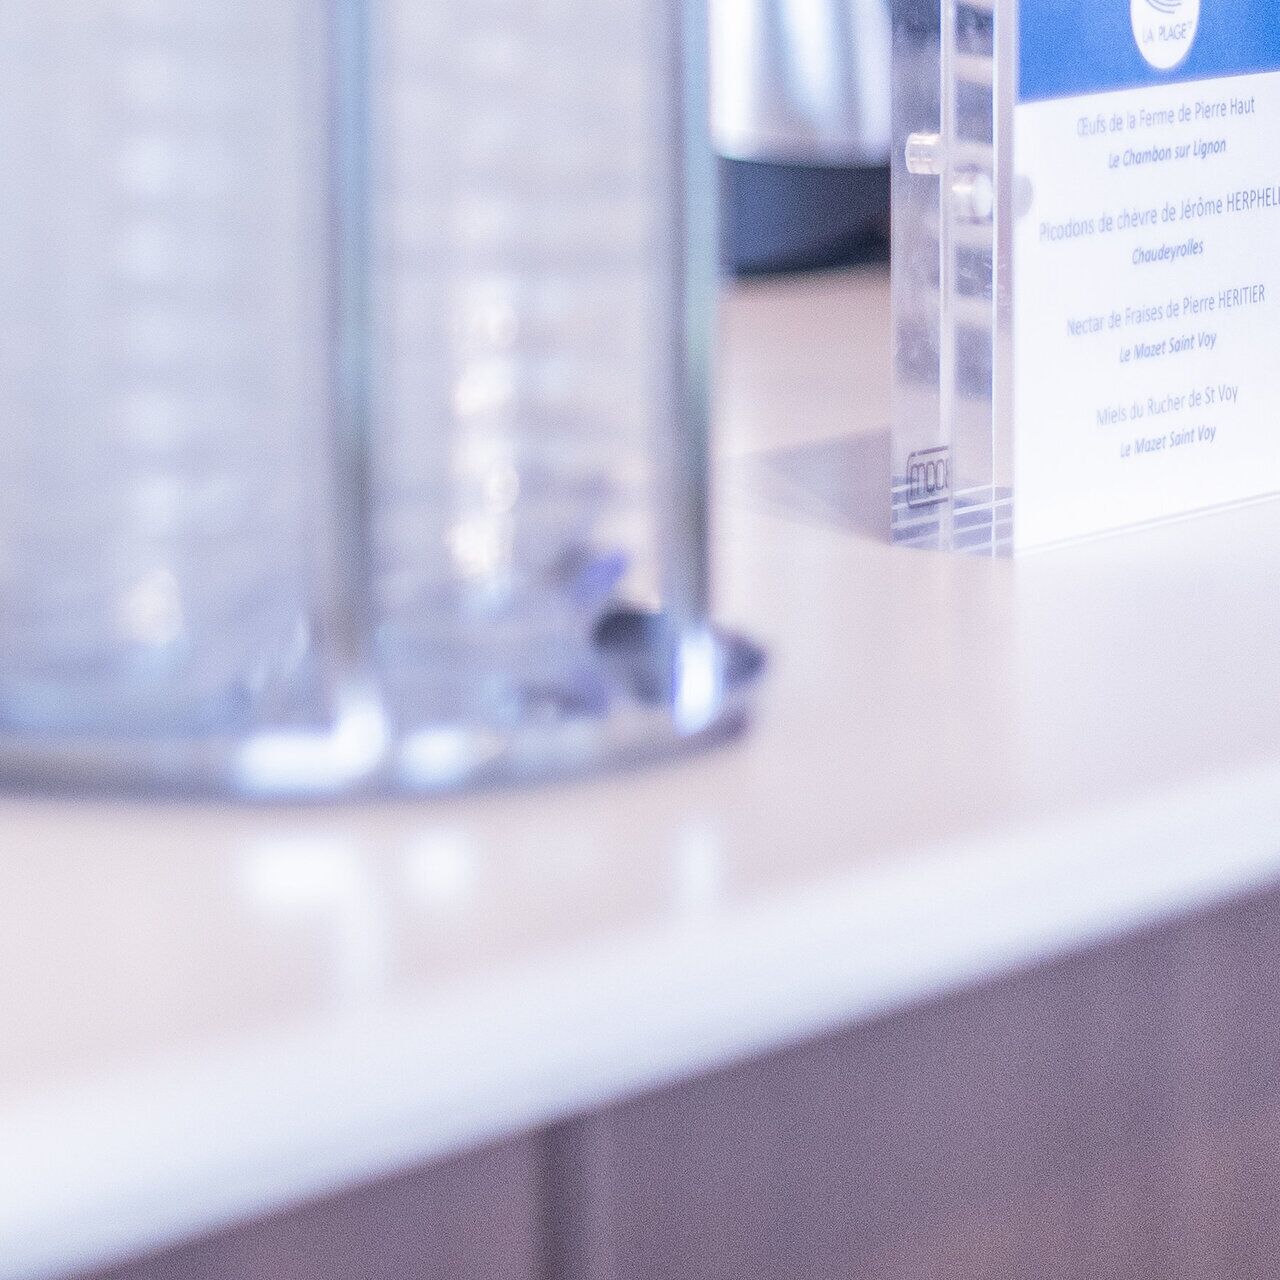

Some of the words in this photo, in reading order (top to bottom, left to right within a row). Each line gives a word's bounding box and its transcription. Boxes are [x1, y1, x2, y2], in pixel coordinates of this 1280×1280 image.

[1142, 24, 1154, 43] LA
[1076, 114, 1106, 137] Œufs
[1109, 112, 1123, 132] de
[1127, 111, 1137, 130] la
[1140, 107, 1174, 127] Ferme
[1179, 103, 1191, 122] de
[1195, 99, 1227, 120] Pierre
[1230, 96, 1255, 115] Haut
[1108, 151, 1120, 169] Le
[1123, 144, 1171, 166] Chambon
[1174, 144, 1190, 159] sur
[1193, 138, 1227, 160] Lignon
[1039, 217, 1095, 243] Picodons
[1099, 211, 1113, 233] de
[1161, 202, 1176, 222] de
[1179, 196, 1223, 220] Jérôme
[1132, 238, 1204, 265] Chaudeyrolles
[1066, 314, 1103, 337] Nectar
[1107, 310, 1121, 329] de
[1125, 306, 1163, 326] Fraises
[1166, 300, 1180, 318] de
[1183, 295, 1215, 315] Pierre
[1218, 283, 1265, 309] HERITIER
[1120, 344, 1131, 363] Le
[1134, 339, 1166, 360] Mazet
[1169, 335, 1195, 353] Saint
[1198, 331, 1217, 350] Voy
[1096, 405, 1127, 426] Miels
[1130, 401, 1144, 420] du
[1147, 396, 1185, 417] Rucher
[1188, 389, 1202, 408] de
[1205, 386, 1215, 404] St
[1219, 383, 1238, 404] Voy
[1120, 440, 1131, 458] Le
[1134, 435, 1167, 455] Mazet
[1170, 429, 1194, 448] Saint
[1198, 424, 1217, 444] Voy
